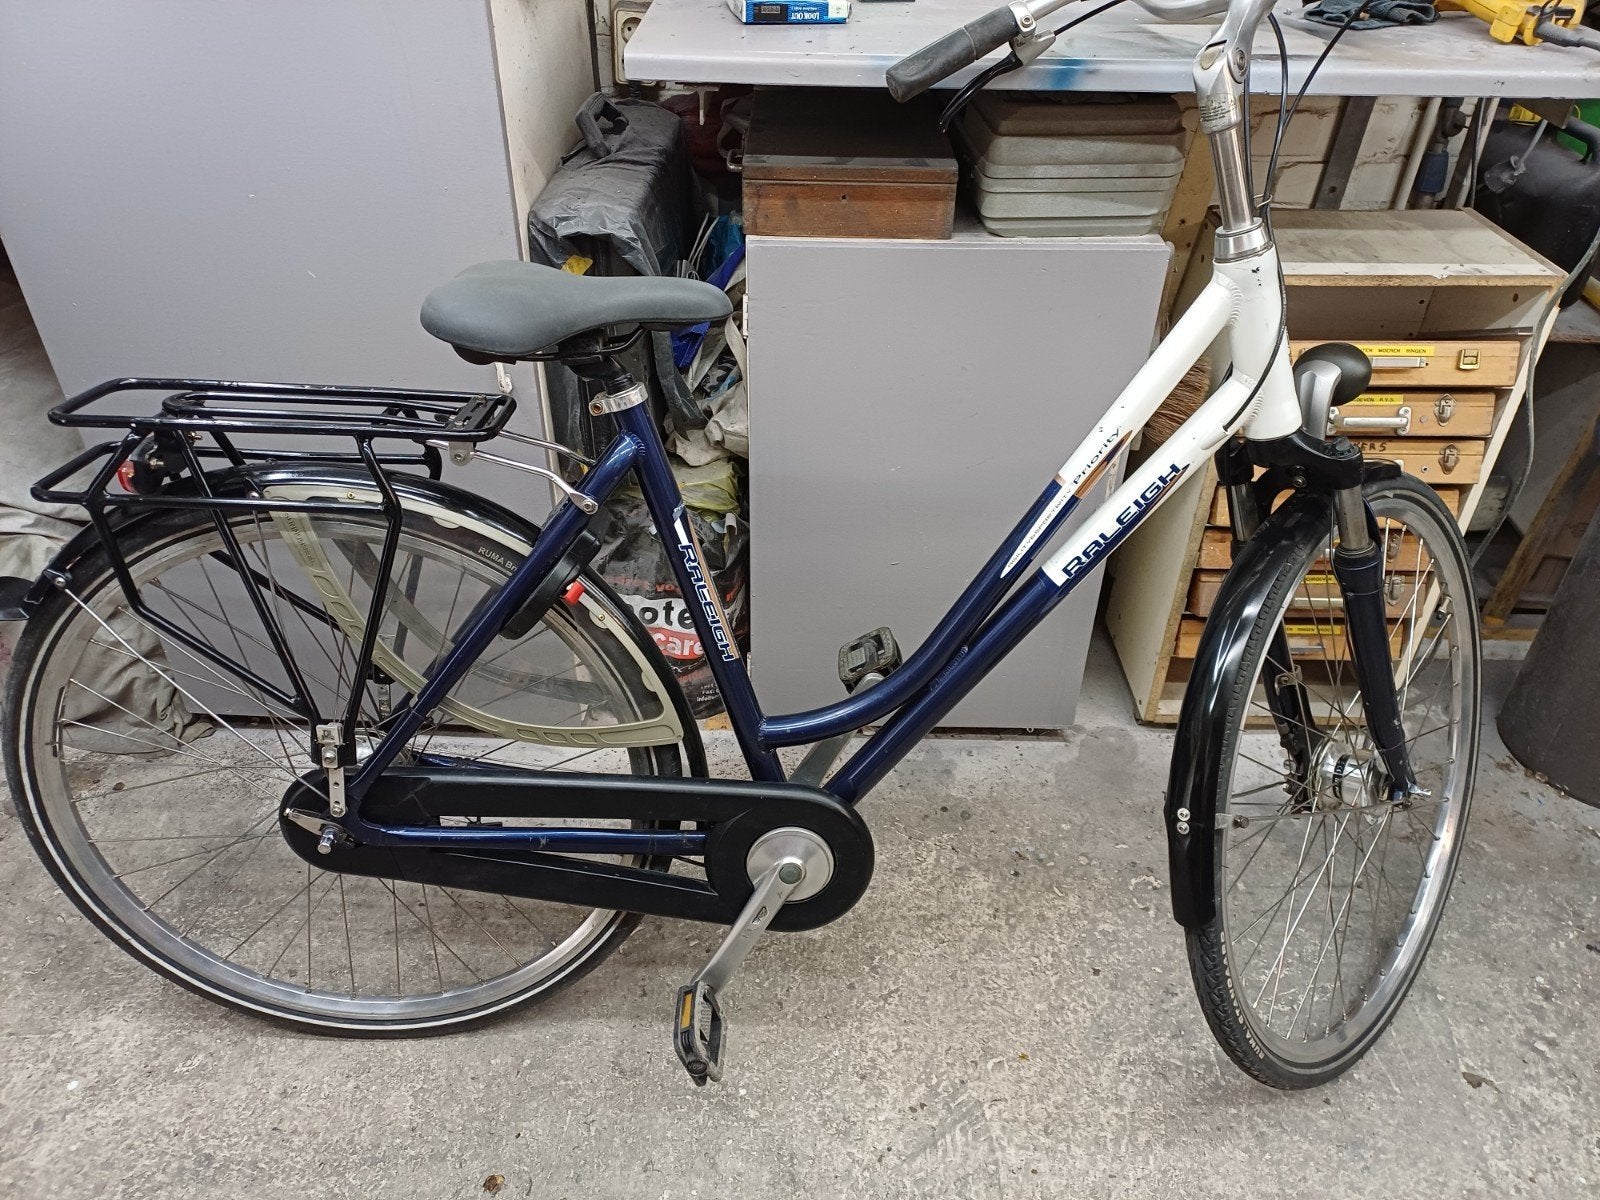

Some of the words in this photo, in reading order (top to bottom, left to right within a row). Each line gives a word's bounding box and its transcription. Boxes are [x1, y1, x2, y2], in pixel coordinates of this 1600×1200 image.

[1073, 427, 1121, 485] Priority
[1061, 463, 1182, 579] RALEIGH
[478, 546, 504, 565] RUMA
[678, 543, 736, 662] RALEIGH
[1246, 1029, 1265, 1060] RUMA
